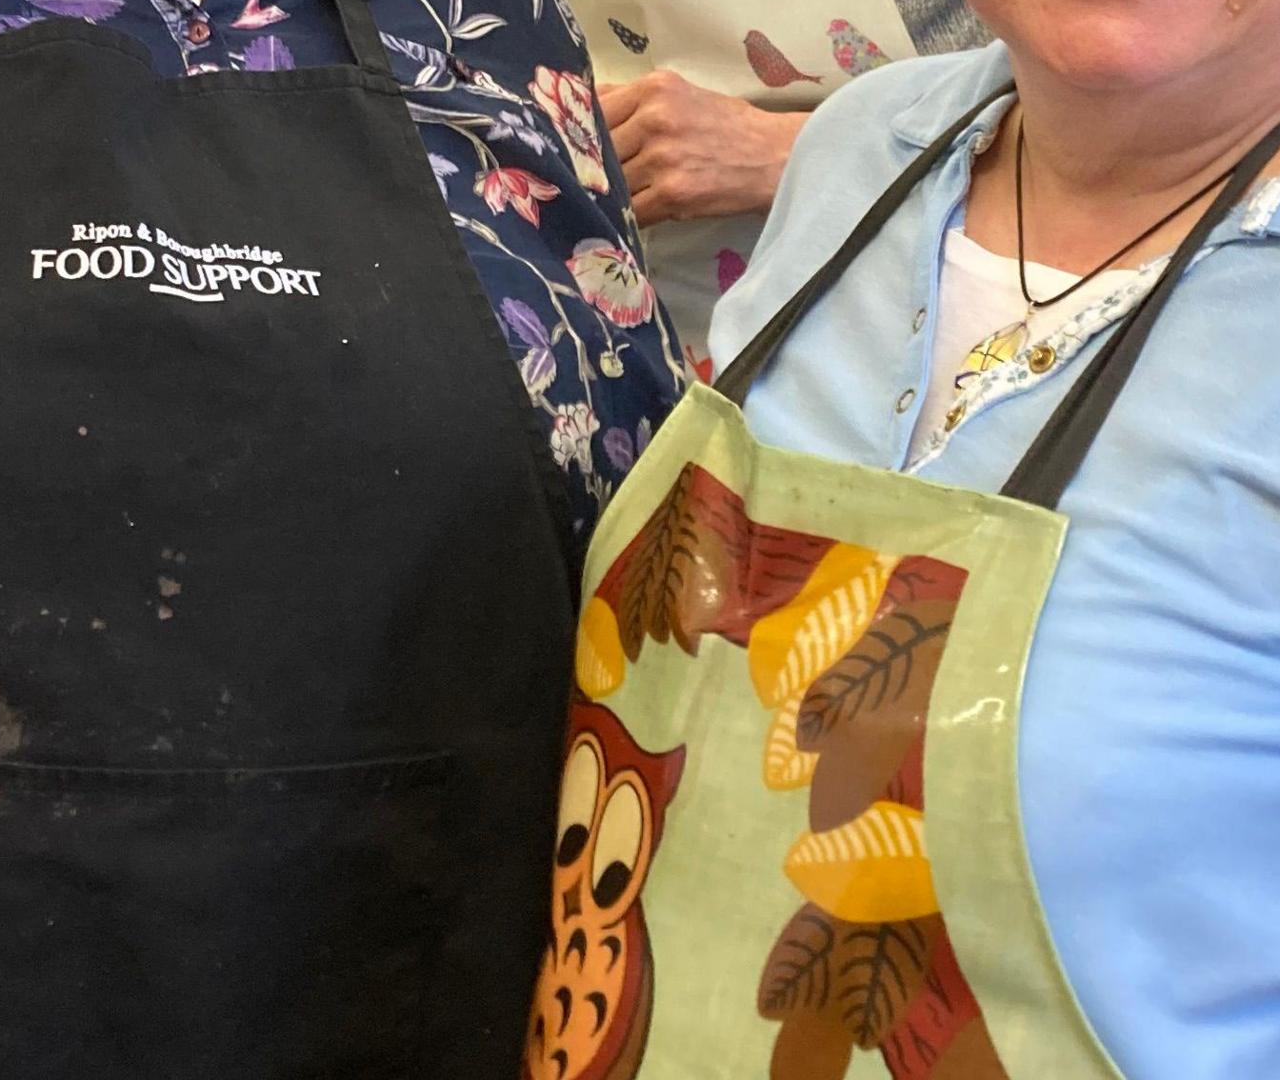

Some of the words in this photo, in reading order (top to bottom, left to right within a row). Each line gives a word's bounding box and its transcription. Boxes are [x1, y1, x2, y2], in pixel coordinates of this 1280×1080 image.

[72, 223, 133, 244] Ripon
[136, 222, 153, 242] &
[155, 228, 284, 265] Boroughbridge
[30, 244, 156, 280] FOOD
[161, 253, 322, 297] SUPPORT
